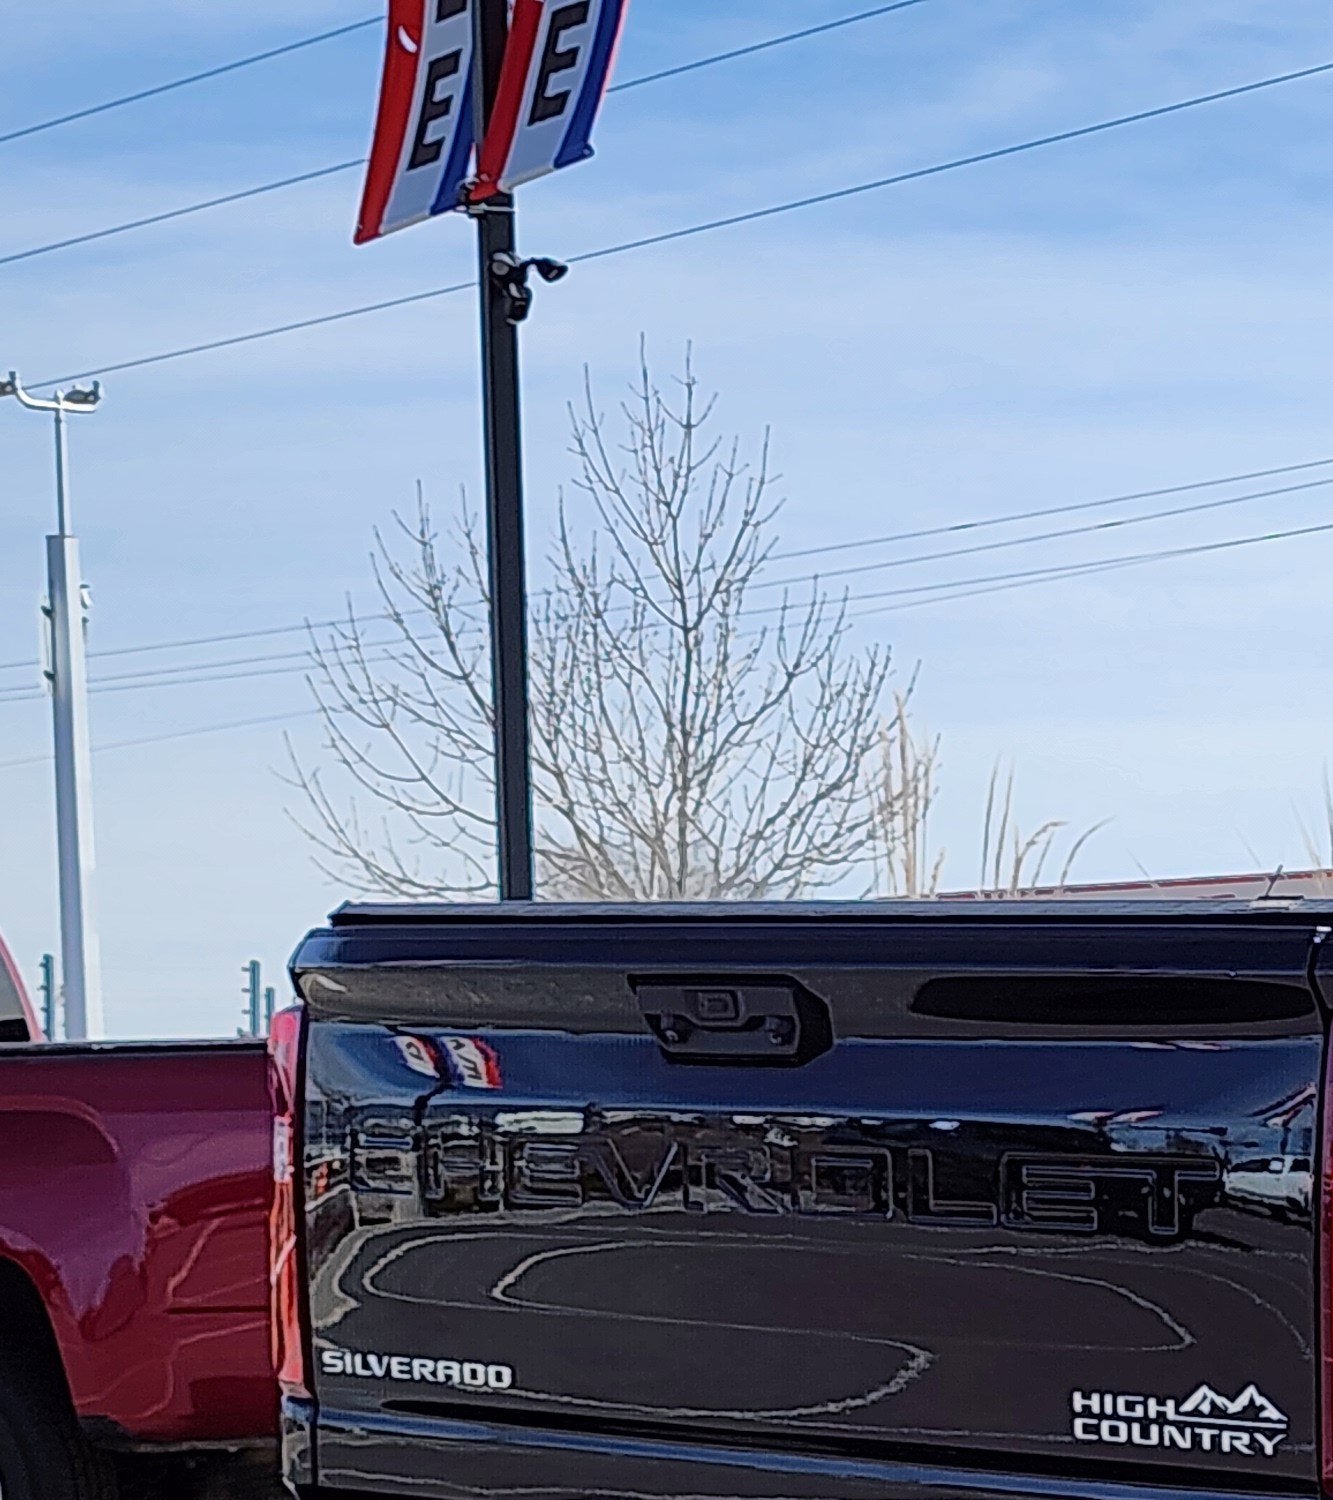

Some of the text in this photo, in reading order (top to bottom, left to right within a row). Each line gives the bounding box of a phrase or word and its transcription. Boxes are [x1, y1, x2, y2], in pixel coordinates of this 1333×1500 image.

[347, 1127, 1221, 1235] CHEVROLET
[321, 1350, 513, 1389] SILVERADO
[1072, 1391, 1176, 1420] HIGH
[1073, 1417, 1287, 1456] COUNTRY
